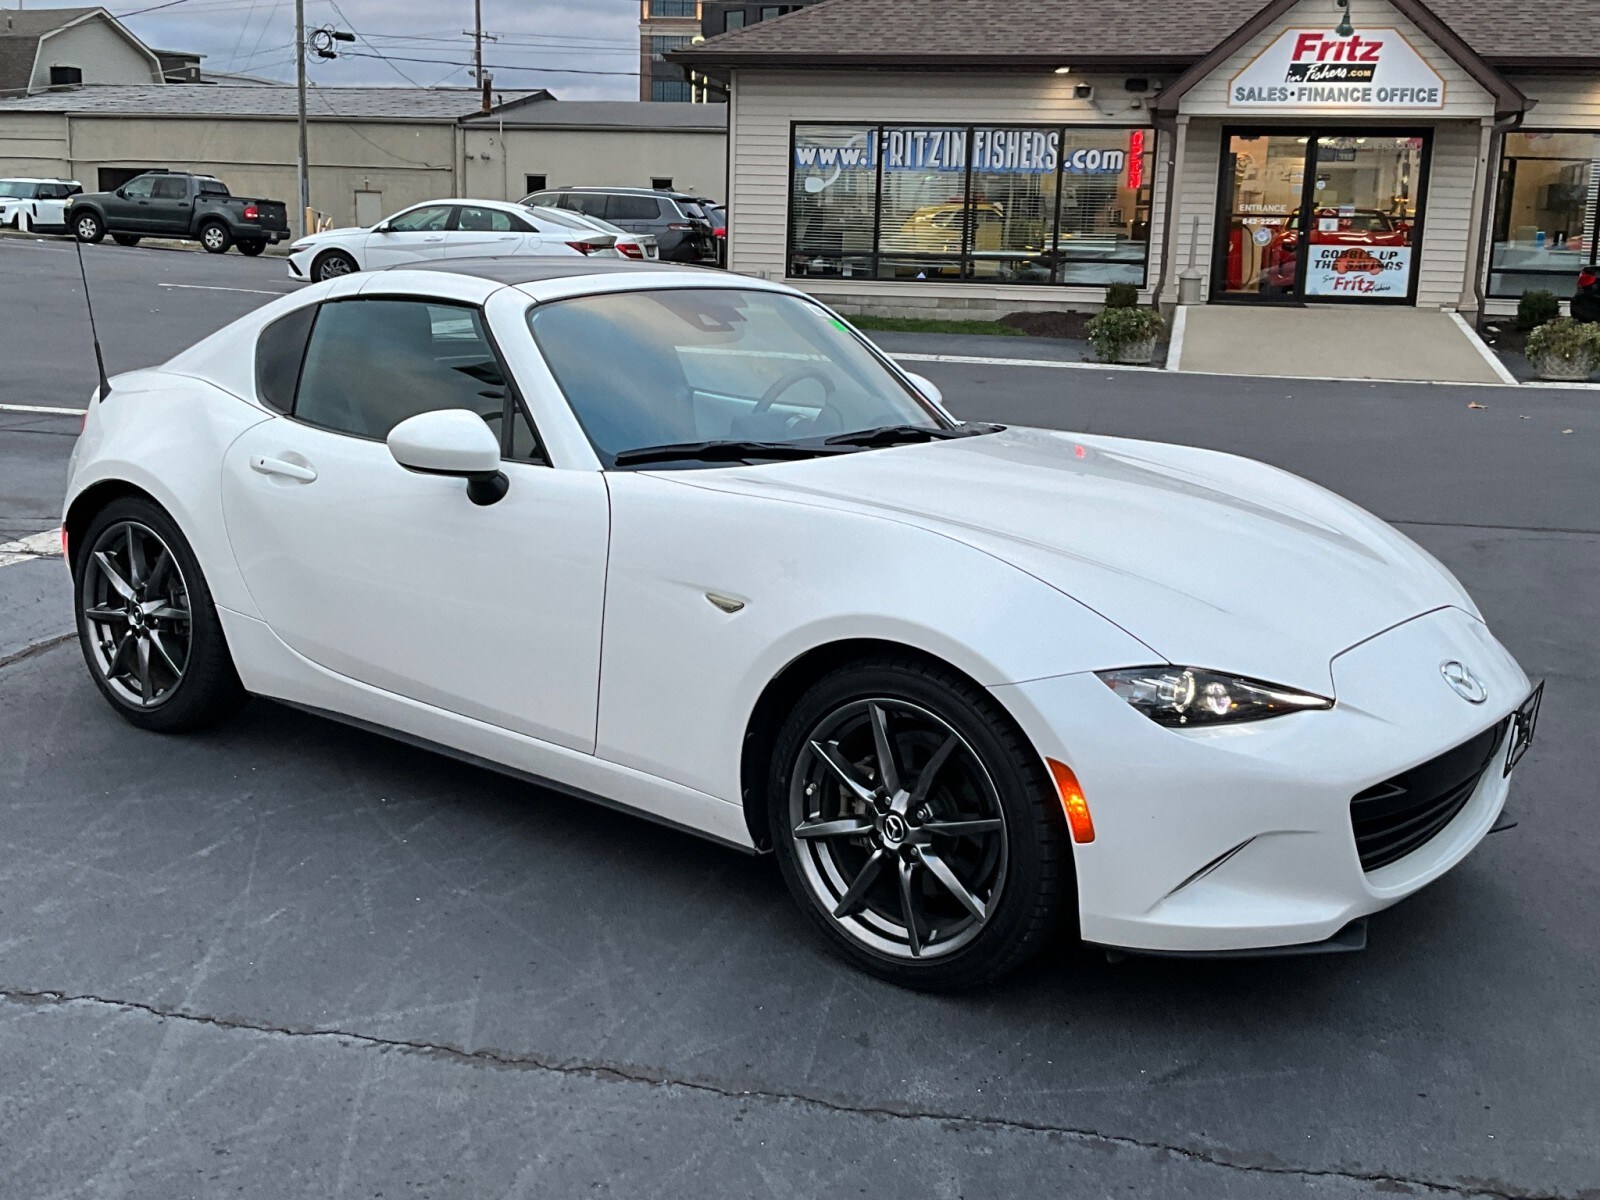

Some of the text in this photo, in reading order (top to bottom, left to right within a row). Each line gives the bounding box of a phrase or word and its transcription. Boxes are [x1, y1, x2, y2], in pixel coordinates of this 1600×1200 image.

[1292, 34, 1383, 61] Fritz
[1287, 71, 1302, 82] in
[1376, 87, 1438, 102] OFFICE
[1130, 131, 1144, 188] OPEN
[1239, 204, 1286, 212] ENTRANCE
[1379, 251, 1398, 260] UP
[1314, 260, 1339, 271] THE
[1333, 275, 1375, 291] Fritz
